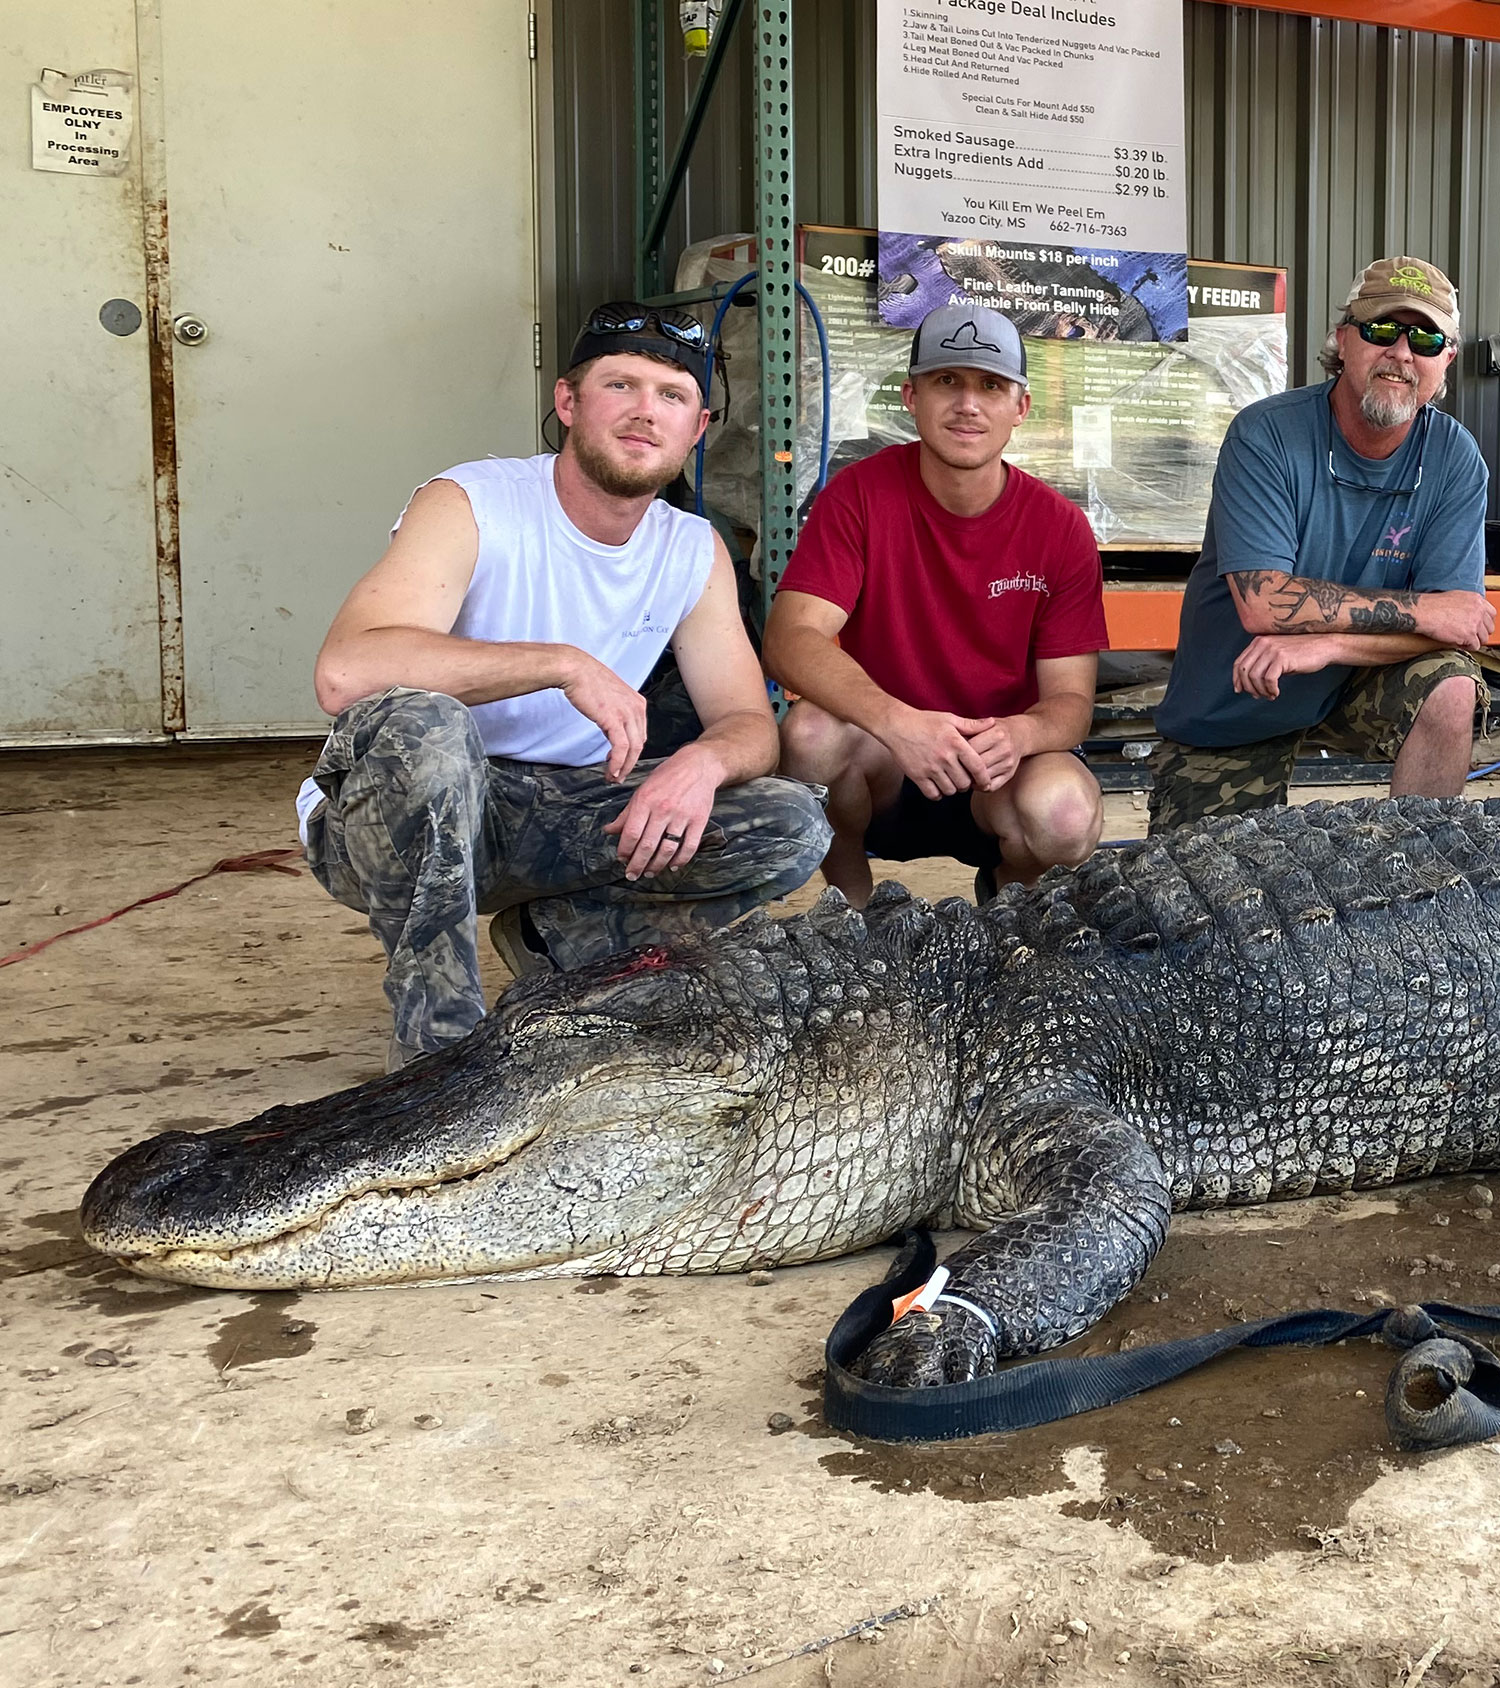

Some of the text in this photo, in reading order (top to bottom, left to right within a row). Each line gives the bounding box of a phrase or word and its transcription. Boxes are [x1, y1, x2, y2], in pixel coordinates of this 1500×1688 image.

[1012, 1, 1046, 18] Deal
[1051, 6, 1116, 27] Includes
[927, 34, 948, 44] Meat
[950, 36, 978, 46] Boned
[980, 40, 994, 49] Out
[1005, 43, 1020, 52] Vac
[1022, 44, 1051, 56] Packed
[1064, 50, 1094, 61] Chunks
[930, 23, 936, 32] &
[938, 24, 954, 34] Tail
[956, 26, 980, 36] Loins
[982, 29, 996, 38] Cut
[998, 30, 1013, 40] Into
[1016, 32, 1060, 46] Tenderized
[1062, 39, 1096, 51] Nuggets
[1098, 44, 1114, 52] And
[1116, 46, 1130, 54] Vac
[1132, 48, 1160, 58] Packed
[928, 46, 950, 56] Meat
[952, 48, 980, 58] Boned
[982, 51, 996, 60] Out
[998, 53, 1014, 62] And
[1016, 56, 1031, 64] Vac
[1034, 58, 1063, 68] Packed
[934, 58, 949, 66] Cut
[951, 59, 968, 69] And
[970, 62, 1010, 73] Returned
[932, 69, 960, 79] Rolled
[962, 72, 979, 81] And
[982, 74, 1020, 85] Returned
[42, 102, 122, 120] EMPLOYEES
[962, 92, 1095, 114] Special Cuts For Mount Add $50
[64, 118, 101, 130] OLNY
[976, 106, 1084, 124] Clean & Salt Hide Add $50
[75, 131, 86, 140] In
[894, 124, 1168, 164] Smoked Sausage $3.39 lb.
[48, 140, 119, 158] Processing
[68, 156, 98, 166] Area
[894, 144, 1170, 182] Extra Ingredients Add $0.20 lb.
[894, 162, 1170, 199] Nuggets $2.99 lb.
[963, 197, 1106, 220] You Kill Em We Peel Em
[941, 211, 976, 225] Yazoo
[1007, 216, 1026, 229] MS
[1049, 220, 1127, 237] 662-716-7363
[821, 254, 876, 278] 200#
[948, 243, 1119, 268] Skull Mounts $18 per inch
[964, 278, 1105, 301] Fine Leather Tanning
[1202, 286, 1260, 310] FEEDER
[948, 293, 1120, 318] Available From Belly Hide
